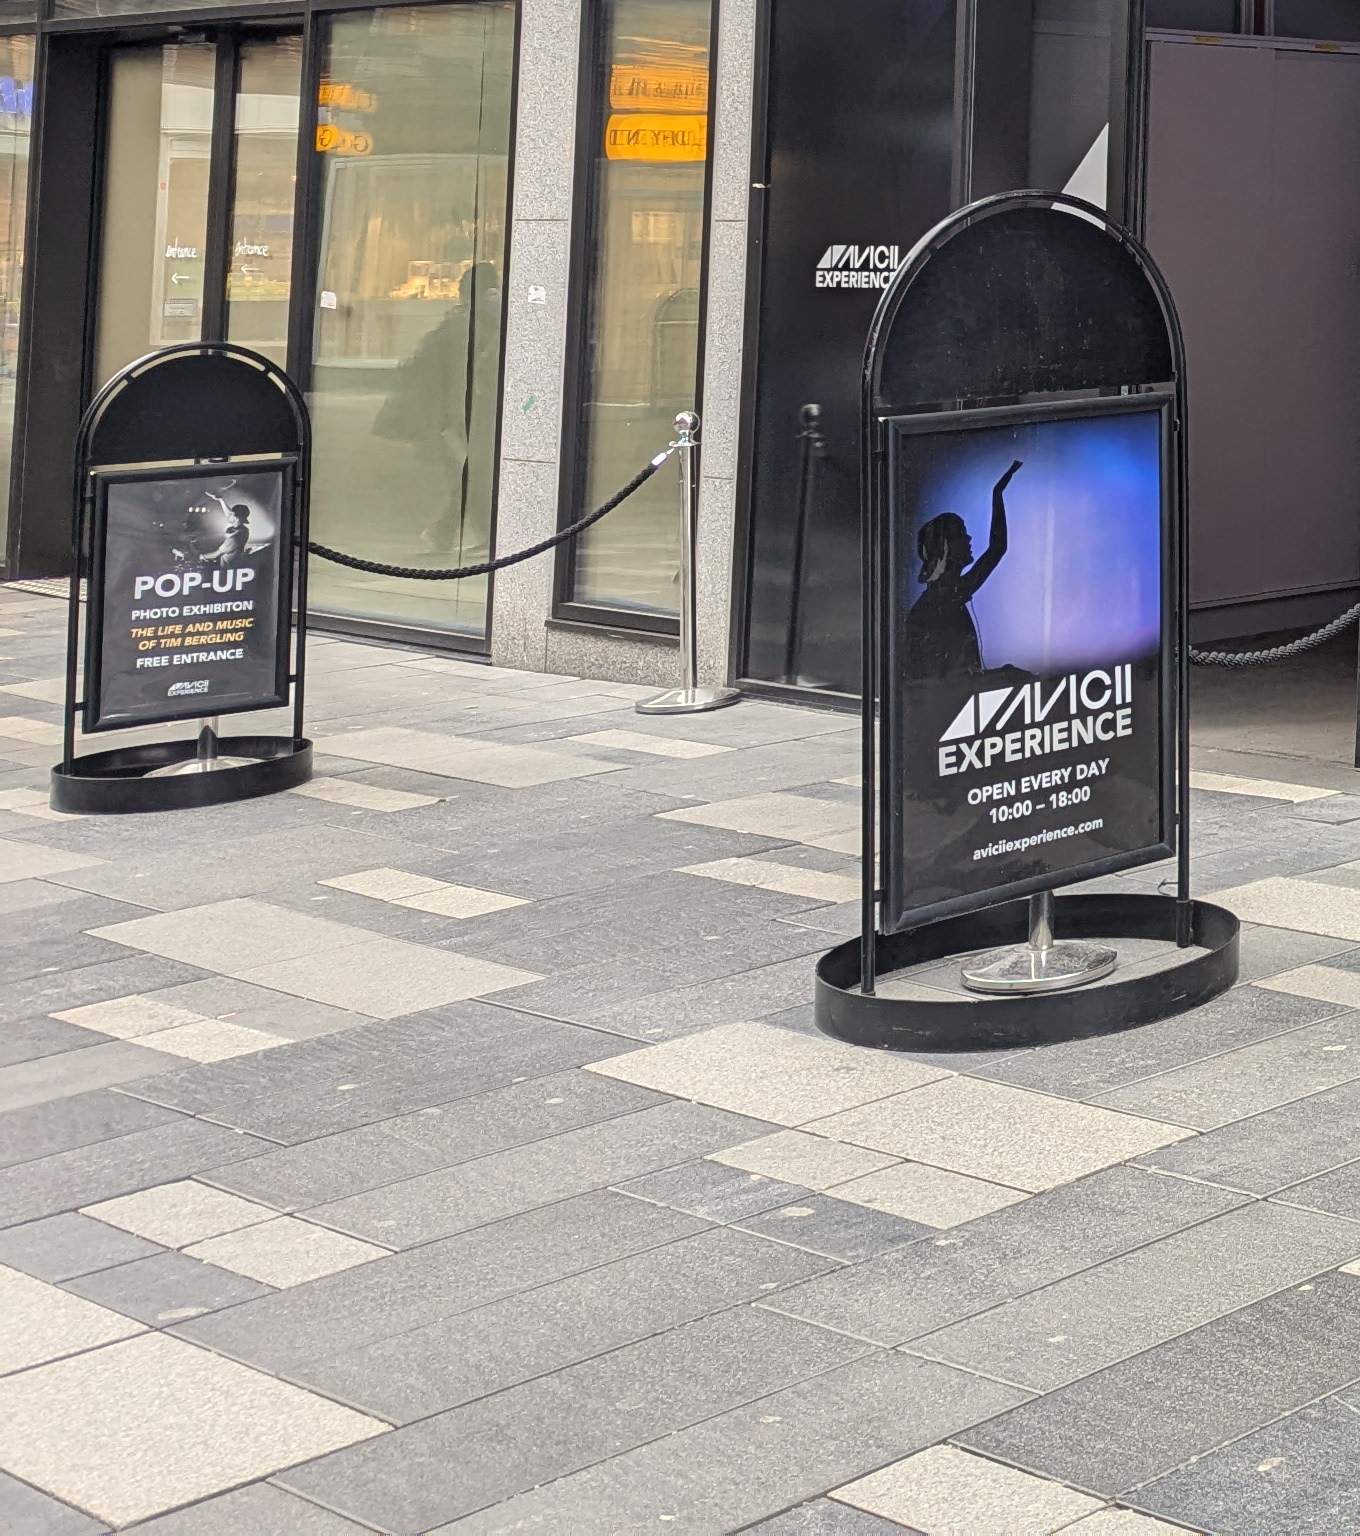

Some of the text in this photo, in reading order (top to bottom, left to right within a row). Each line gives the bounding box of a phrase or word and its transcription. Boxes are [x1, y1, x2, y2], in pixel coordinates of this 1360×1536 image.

[837, 245, 899, 269] AVICII
[133, 568, 255, 600] POP-UP
[131, 600, 254, 620] PHOTO EXHIBITON
[130, 617, 255, 638] THE LIFE AND MUSIC
[138, 631, 245, 651] OF TIM BERGLING
[136, 648, 244, 669] FREE ENTRANCE
[995, 664, 1133, 731] AVICII
[938, 707, 1133, 777] EXPERIENCE
[967, 757, 1111, 805] OPEN EVERY DAY
[988, 799, 1033, 824] 10:00
[1049, 785, 1091, 810] 18:00
[972, 818, 1104, 861] aviciiexperience.com
